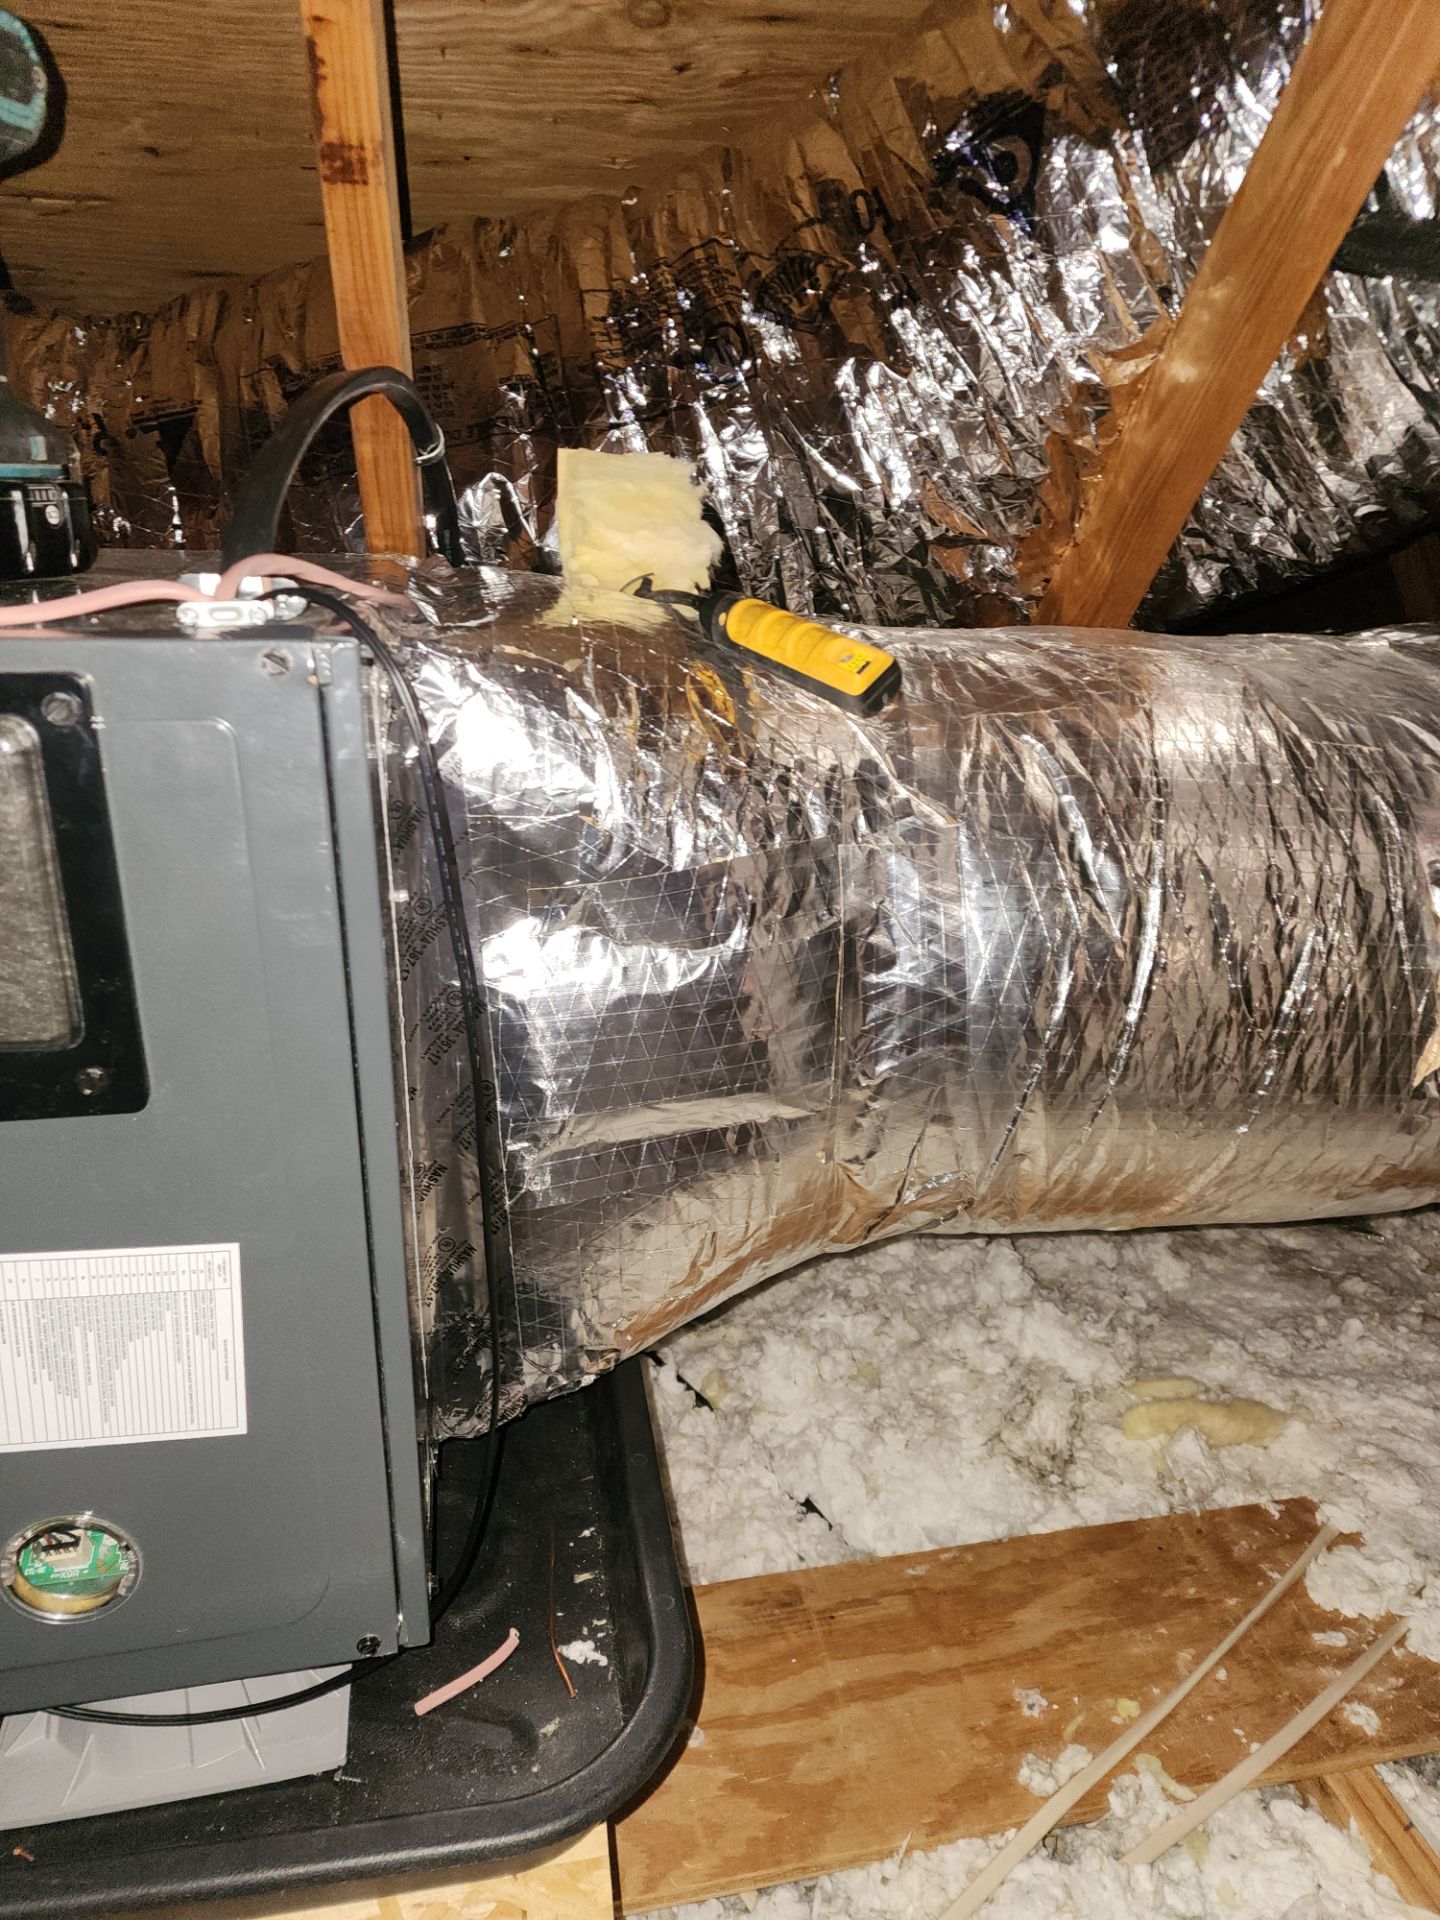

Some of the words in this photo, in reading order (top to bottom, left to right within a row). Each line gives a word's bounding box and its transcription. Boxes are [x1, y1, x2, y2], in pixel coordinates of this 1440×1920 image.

[427, 1035, 457, 1066] 367-17
[420, 1164, 448, 1202] NASHUA
[446, 1243, 477, 1276] NASHUA
